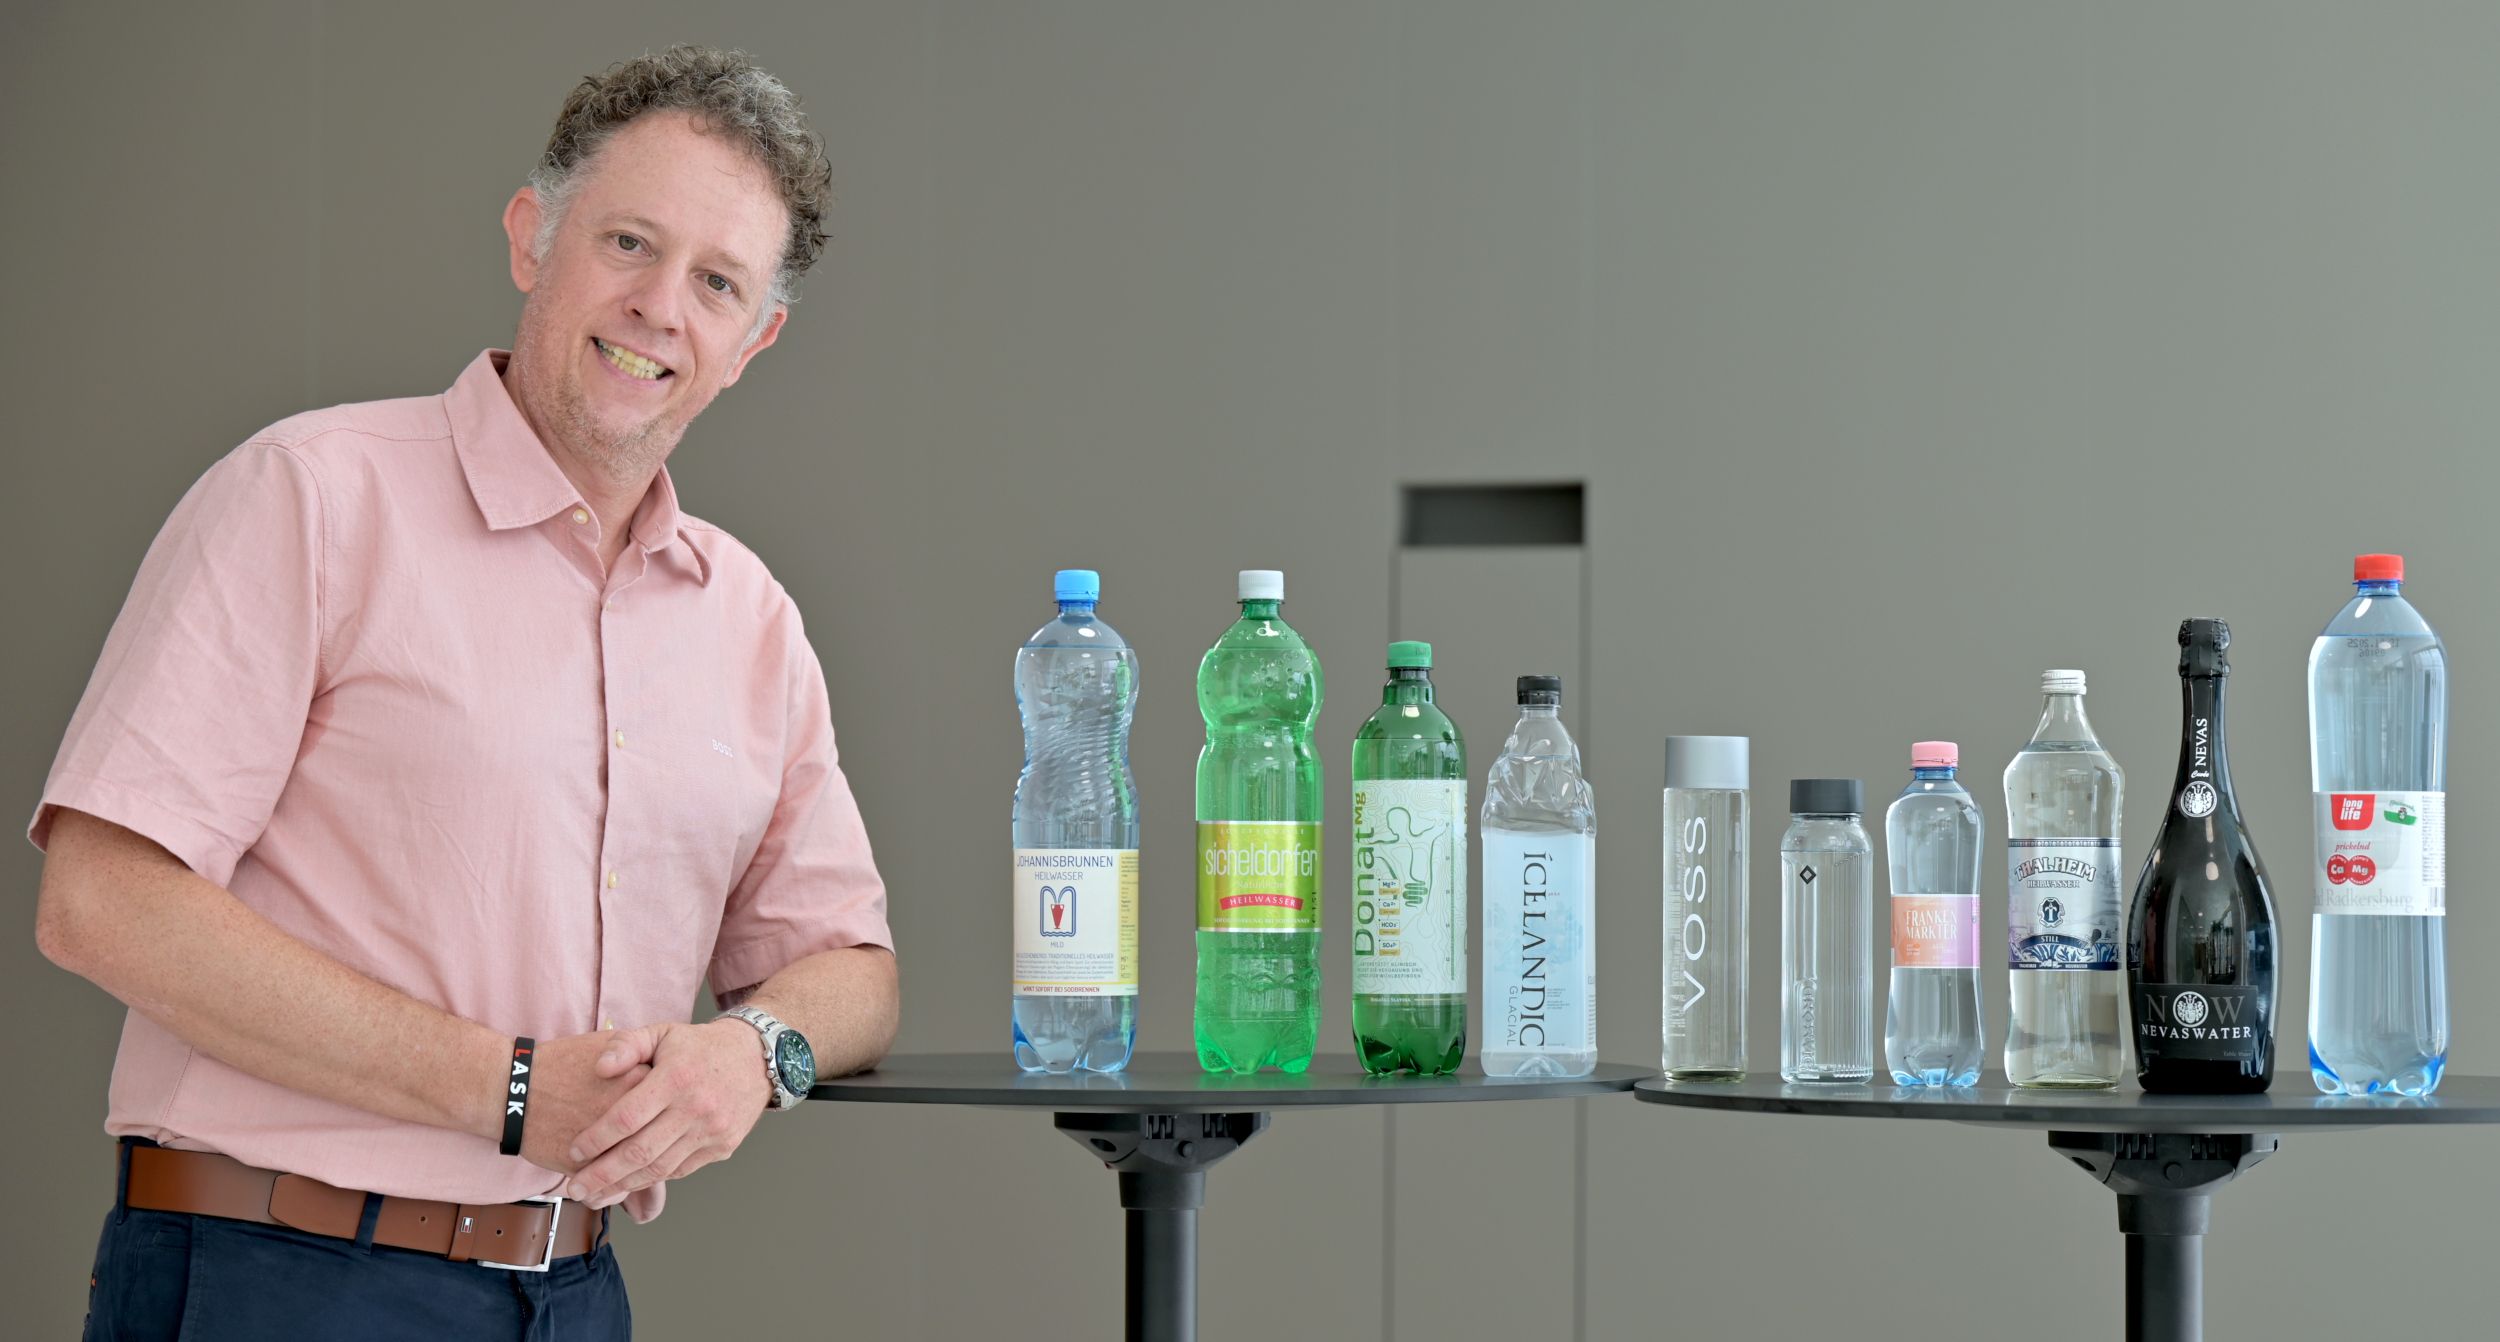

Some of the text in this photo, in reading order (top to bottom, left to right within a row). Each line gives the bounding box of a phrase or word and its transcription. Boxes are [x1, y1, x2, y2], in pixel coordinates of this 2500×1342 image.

[2195, 718, 2208, 767] NEVAS
[2343, 798, 2363, 809] long
[2340, 807, 2361, 820] life
[2335, 841, 2371, 852] prickelnd
[1016, 855, 1113, 867] JOHANNISBRUNNEN
[1205, 842, 1318, 876] sicheldorfer
[1034, 871, 1083, 880] HEILWASSER
[2014, 857, 2097, 882] THALHEIM
[2331, 864, 2369, 876] Ca Mg
[1354, 826, 1375, 956] Donat
[2027, 880, 2080, 888] HEILWASSER
[1229, 895, 1296, 907] HEILWASSER
[2325, 887, 2415, 913] Radkersburg
[1683, 816, 1707, 1012] VOSS
[1906, 910, 1957, 927] FRANKEN
[1906, 924, 1957, 939] MARKTER
[1506, 985, 1519, 1046] GLACIAL
[2141, 1023, 2252, 1040] NEVASWATER
[506, 1048, 532, 1117] LASK
